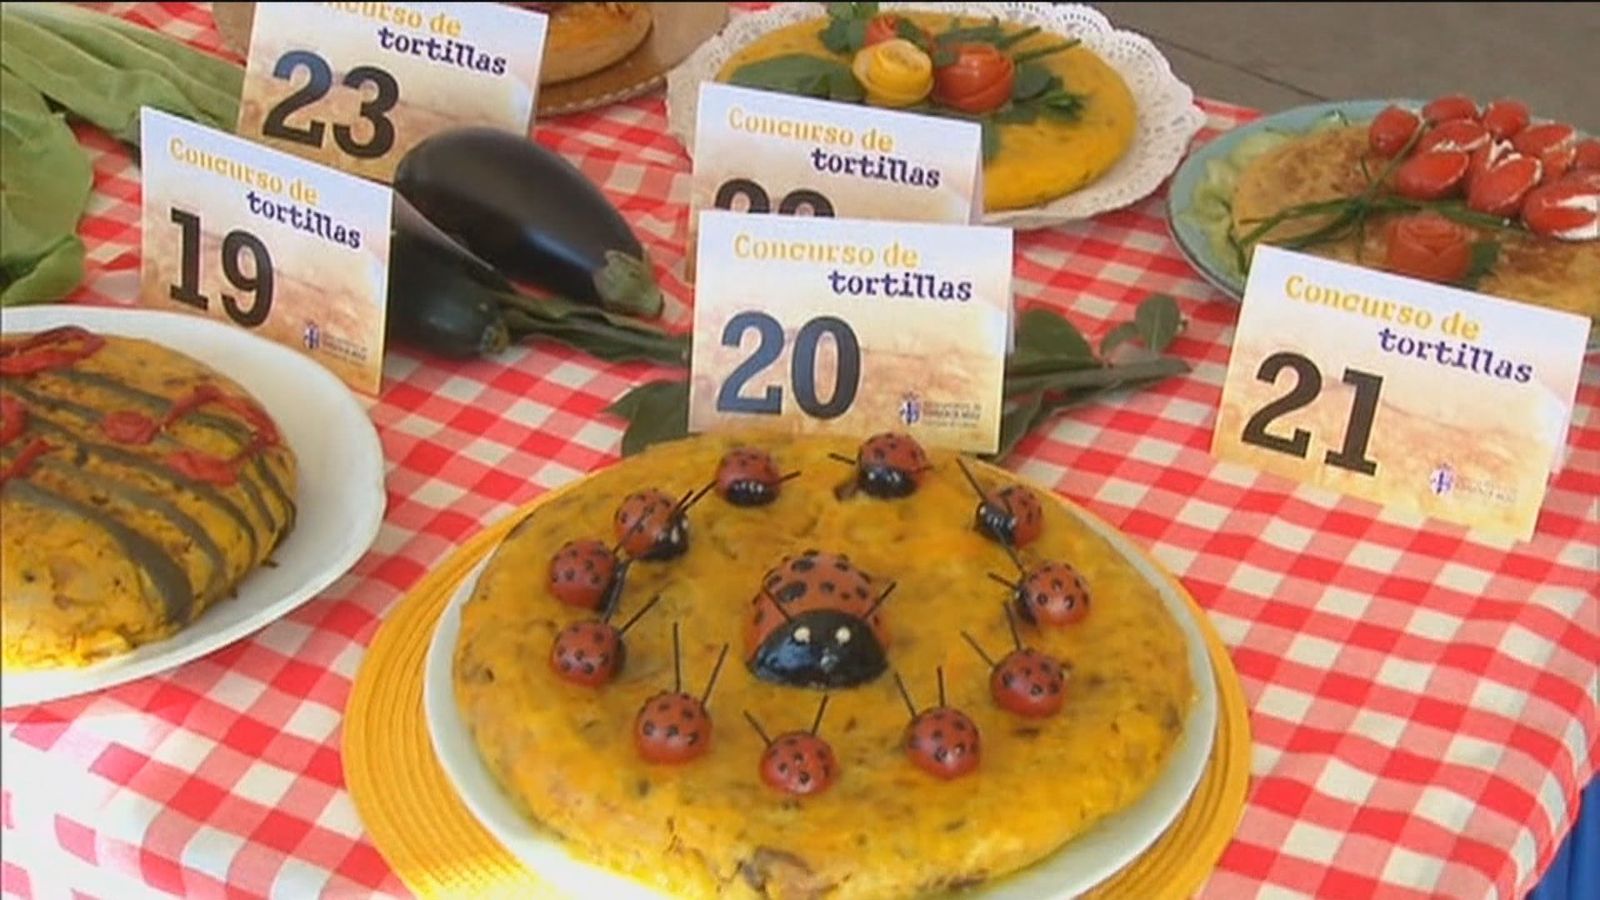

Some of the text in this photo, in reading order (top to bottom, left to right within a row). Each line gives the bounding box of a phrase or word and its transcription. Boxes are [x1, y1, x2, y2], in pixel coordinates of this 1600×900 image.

[378, 26, 507, 76] tortillas
[430, 11, 463, 36] de
[262, 50, 399, 160] 23
[728, 107, 894, 152] Concurso de
[169, 138, 319, 205] Concurso de
[811, 147, 941, 188] tortillas
[246, 190, 361, 250] tortillas
[169, 206, 274, 328] 19
[734, 234, 920, 268] Concurso de
[828, 270, 972, 301] tortillas
[1285, 273, 1480, 341] Concurso de
[717, 310, 861, 420] 20
[1379, 326, 1533, 384] tortillas
[1241, 351, 1385, 477] 21
